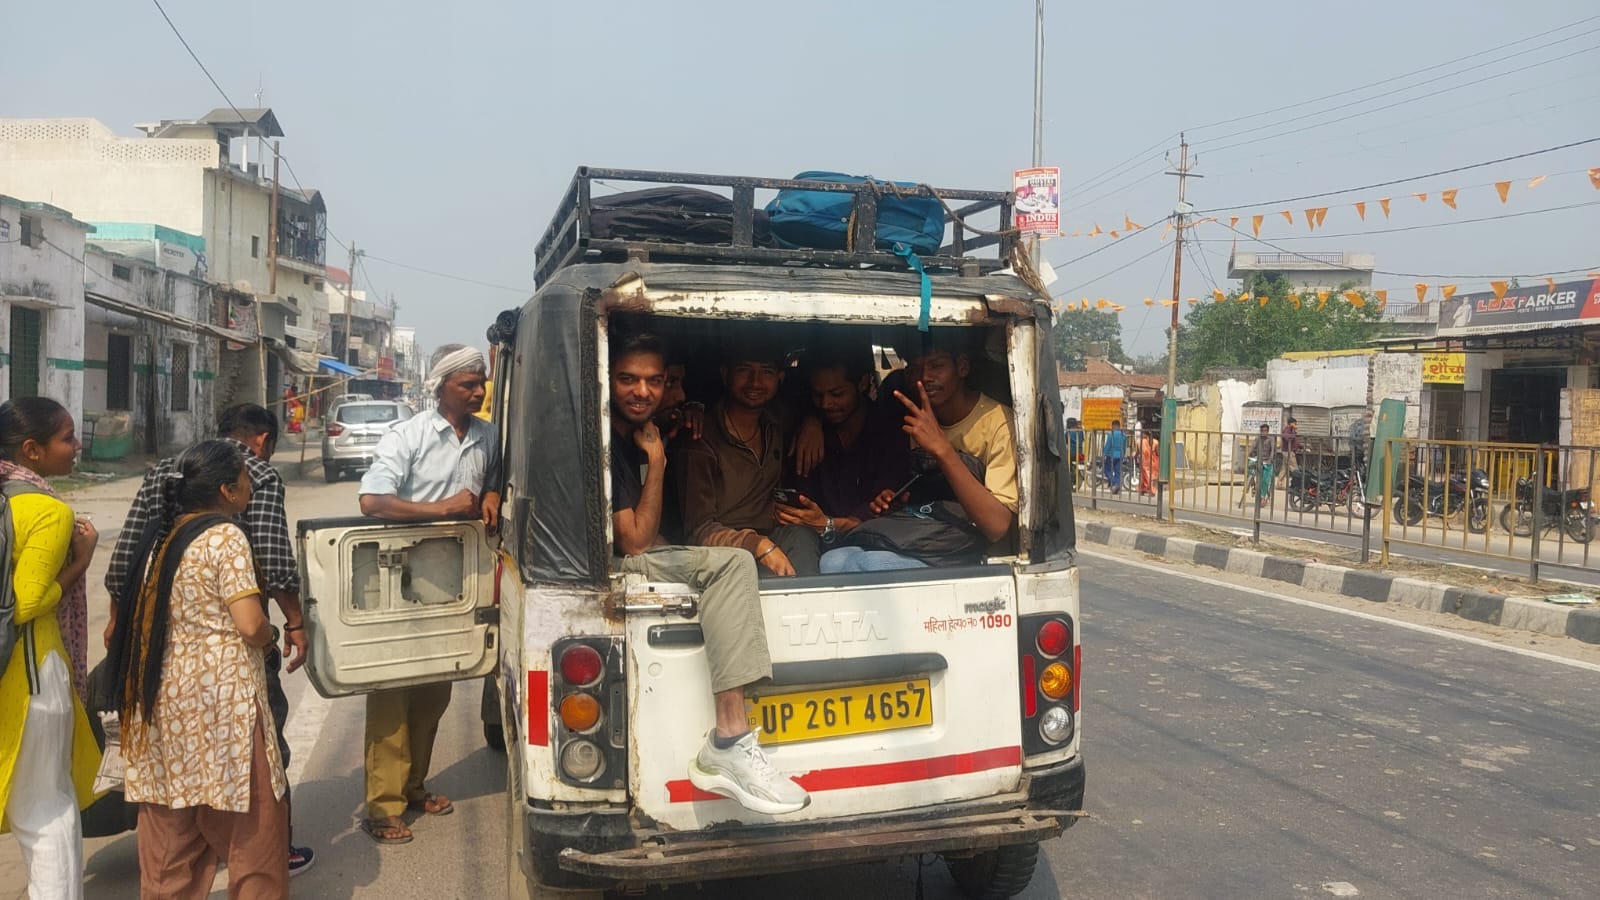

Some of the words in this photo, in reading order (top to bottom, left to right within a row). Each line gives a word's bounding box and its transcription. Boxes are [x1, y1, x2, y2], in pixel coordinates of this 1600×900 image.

[1026, 213, 1056, 222] INDUS
[1517, 290, 1576, 308] PARKER
[964, 596, 1006, 614] magic
[782, 611, 888, 646] TATA
[923, 616, 947, 633] महिला
[979, 614, 1012, 630] 1090
[762, 703, 793, 734] UP
[805, 695, 853, 730] 26T
[864, 687, 926, 723] 4657
